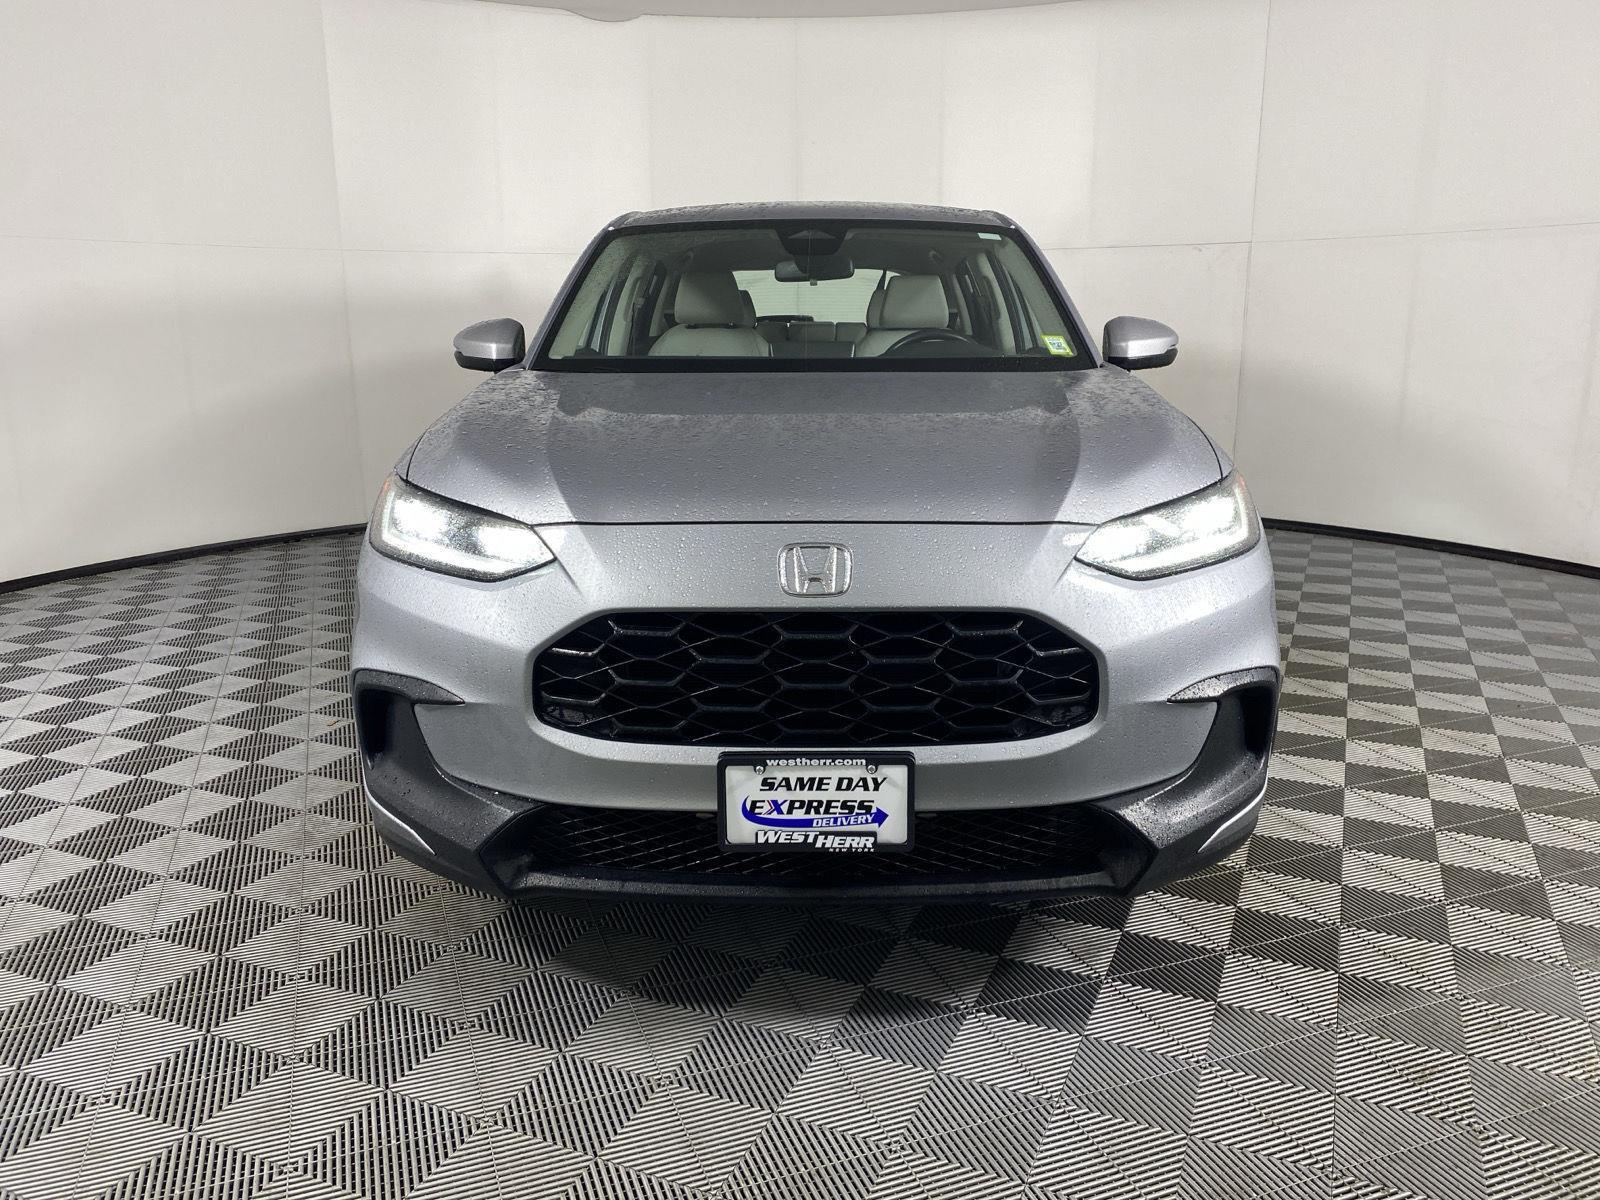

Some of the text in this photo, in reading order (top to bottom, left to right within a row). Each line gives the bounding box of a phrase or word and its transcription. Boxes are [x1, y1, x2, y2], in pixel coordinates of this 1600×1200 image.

[766, 758, 866, 766] westherr.com
[759, 777, 888, 792] SAME DAY
[749, 800, 875, 816] EXPRESS
[812, 814, 875, 828] DELIVERY
